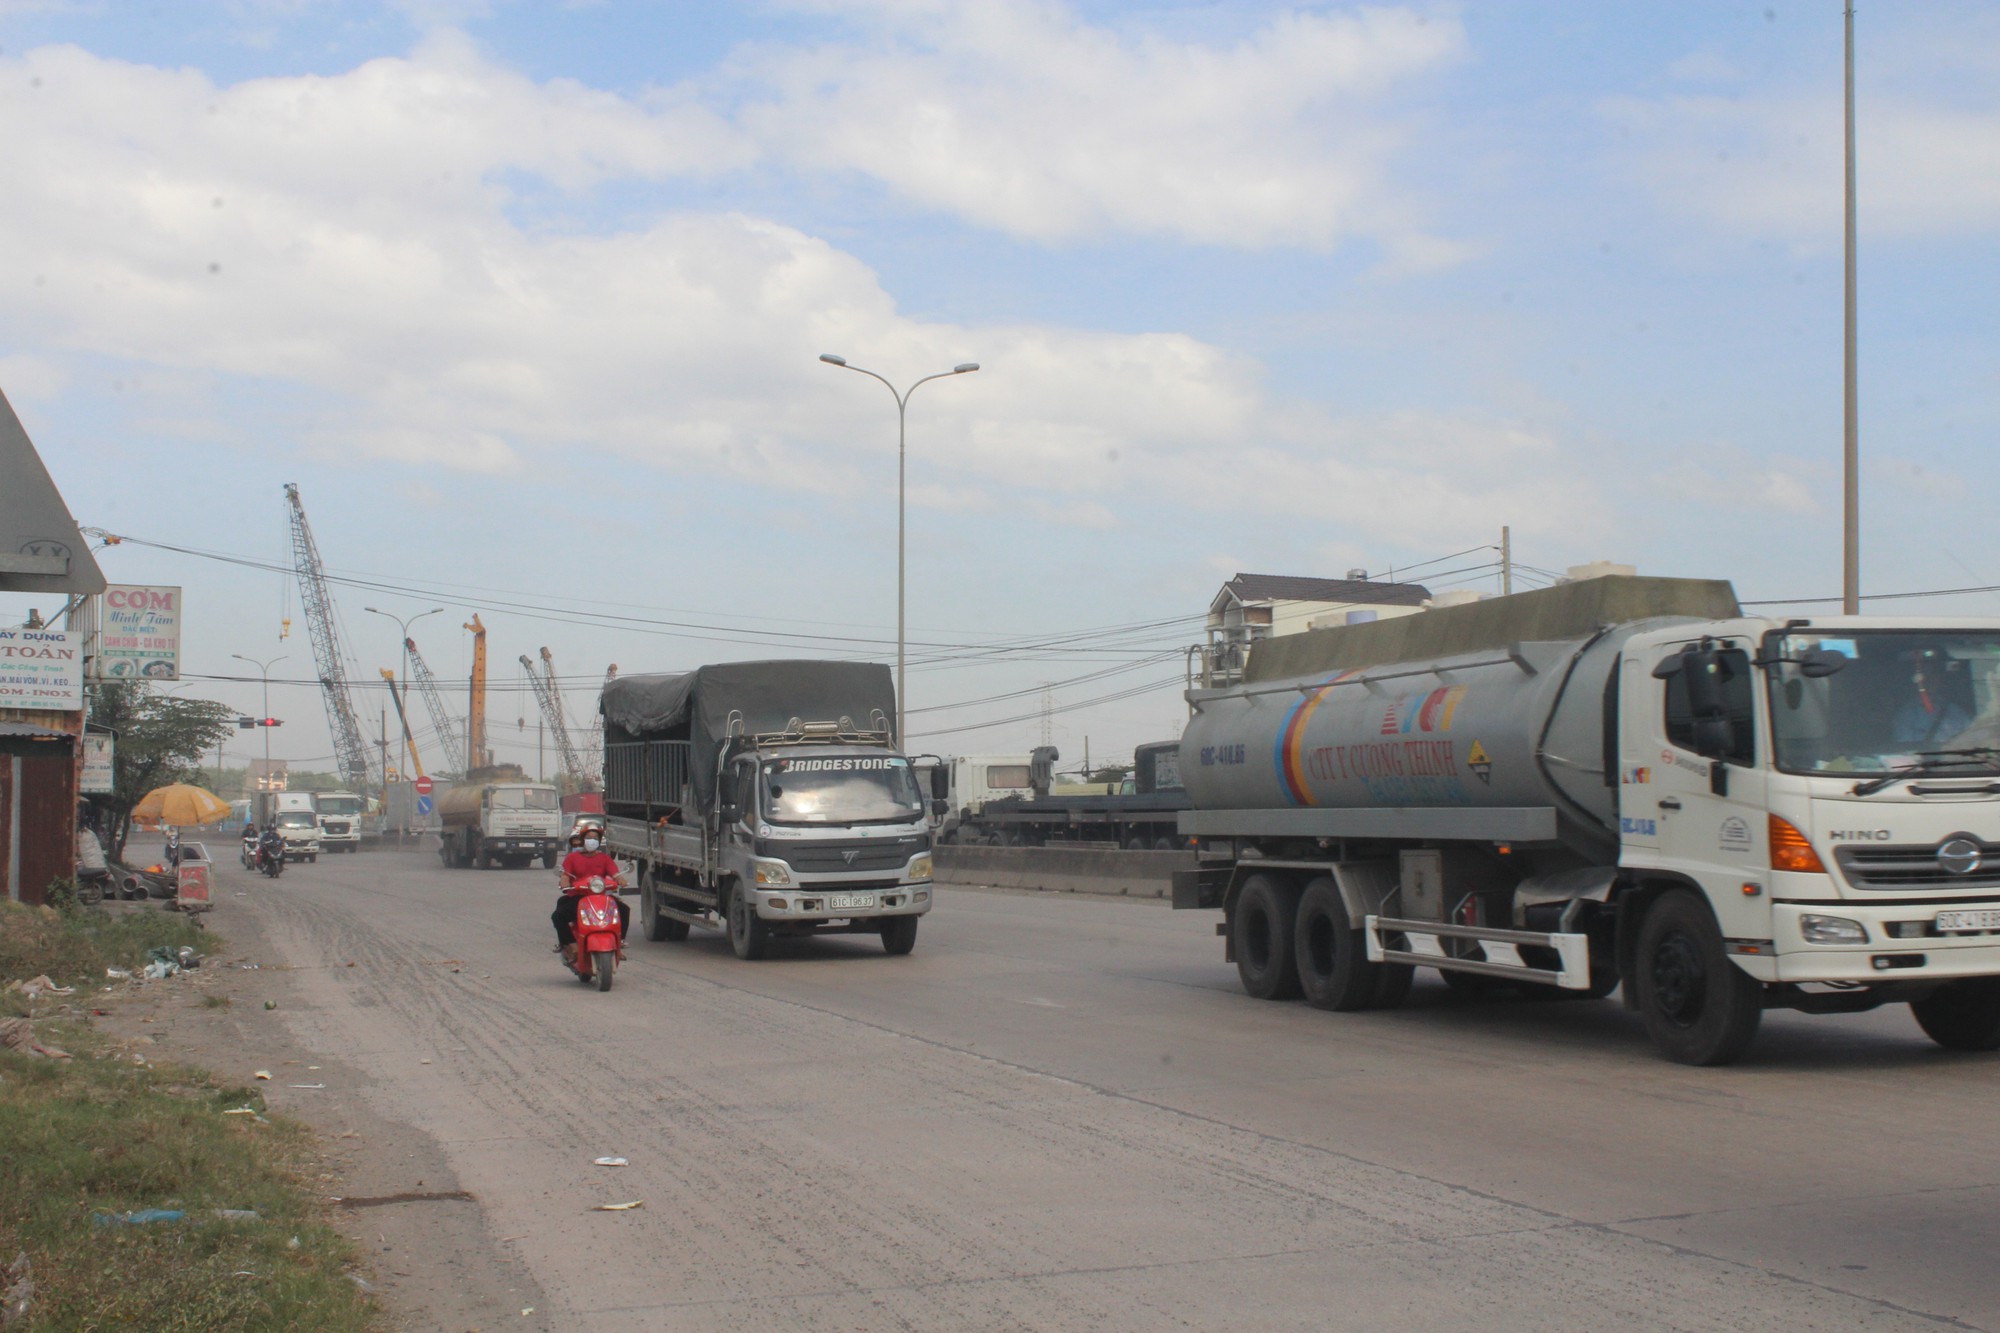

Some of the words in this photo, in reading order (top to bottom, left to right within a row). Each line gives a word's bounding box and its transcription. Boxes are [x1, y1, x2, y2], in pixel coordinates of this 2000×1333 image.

[107, 588, 173, 610] CƠM
[23, 632, 66, 643] DỰNG
[1, 644, 75, 660] TOẢN
[33, 689, 72, 698] INOX
[1829, 829, 1890, 841] HINO
